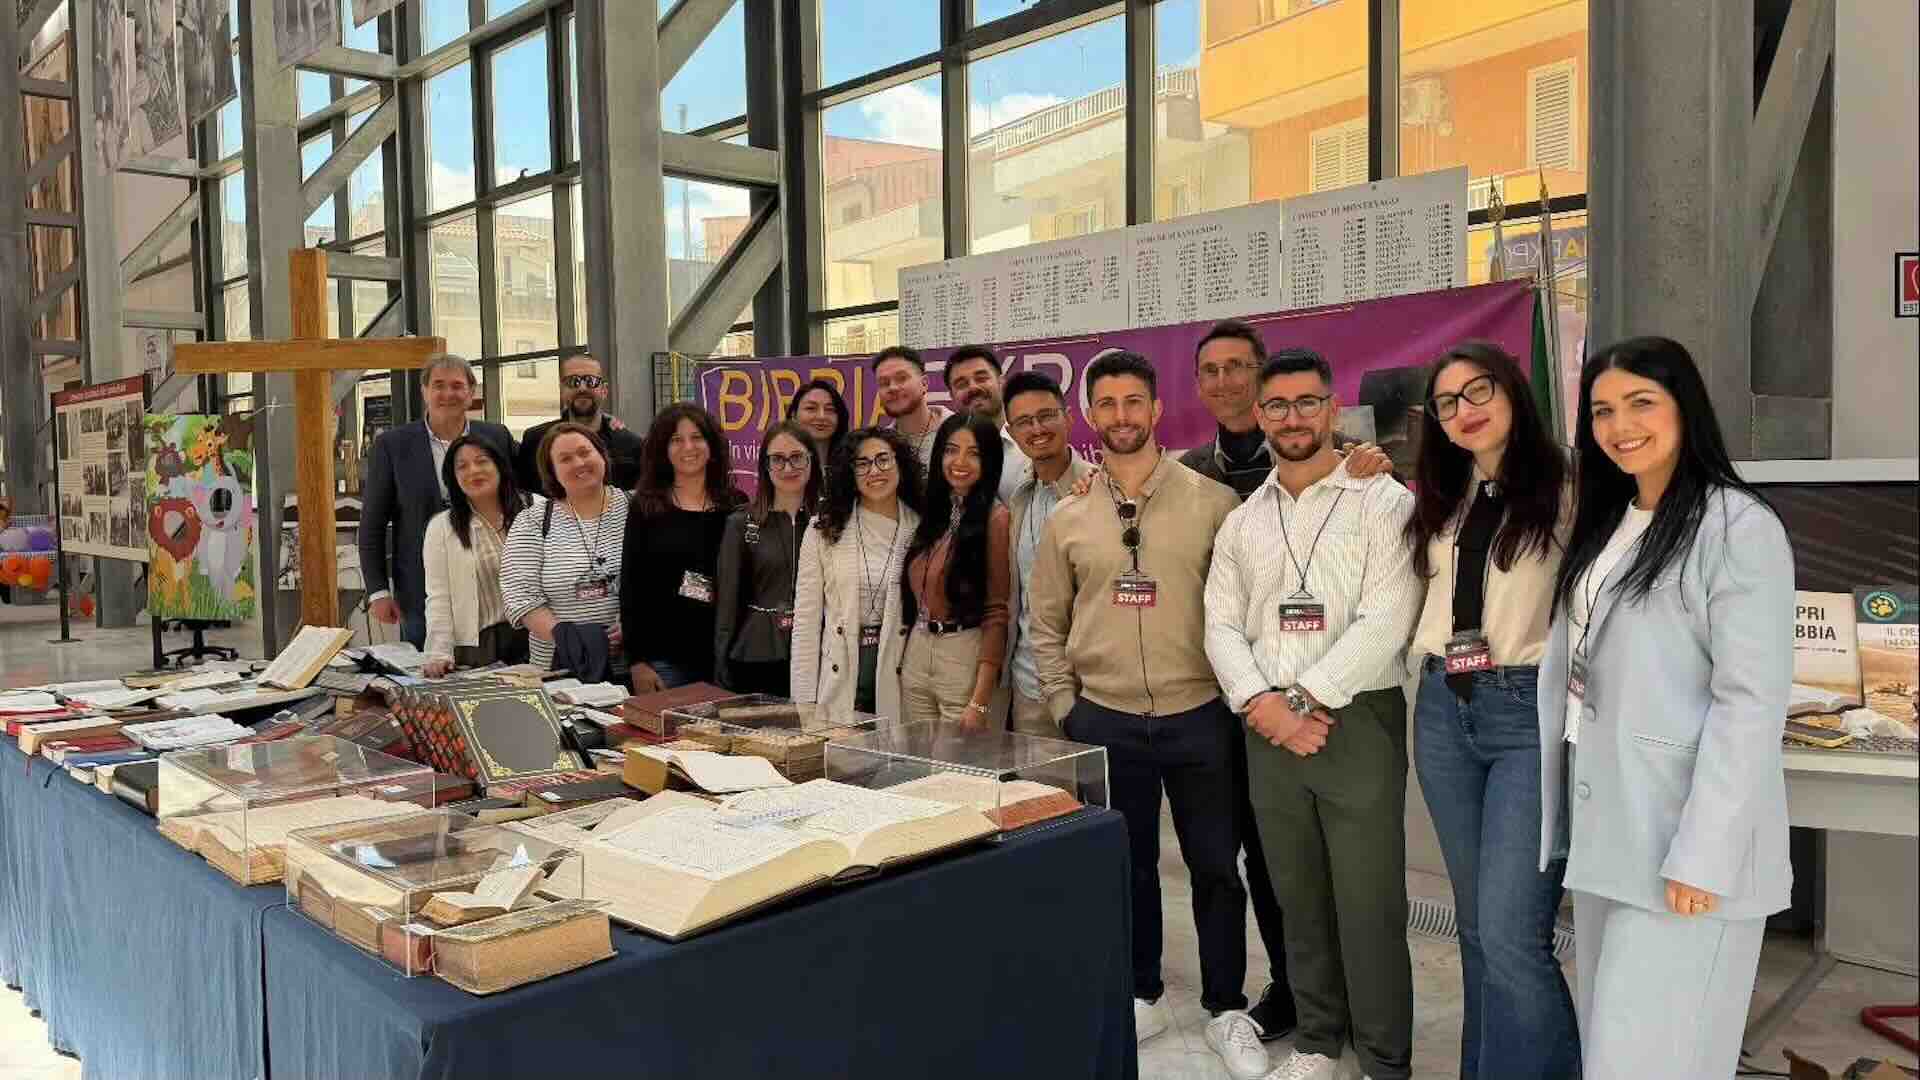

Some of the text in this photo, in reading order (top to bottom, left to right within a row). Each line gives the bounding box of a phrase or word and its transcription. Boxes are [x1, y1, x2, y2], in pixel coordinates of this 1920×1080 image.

[1118, 593, 1151, 604] STAFF
[1283, 620, 1320, 631] STAFF
[1795, 624, 1836, 641] BBIA
[1452, 655, 1488, 670] STAFF
